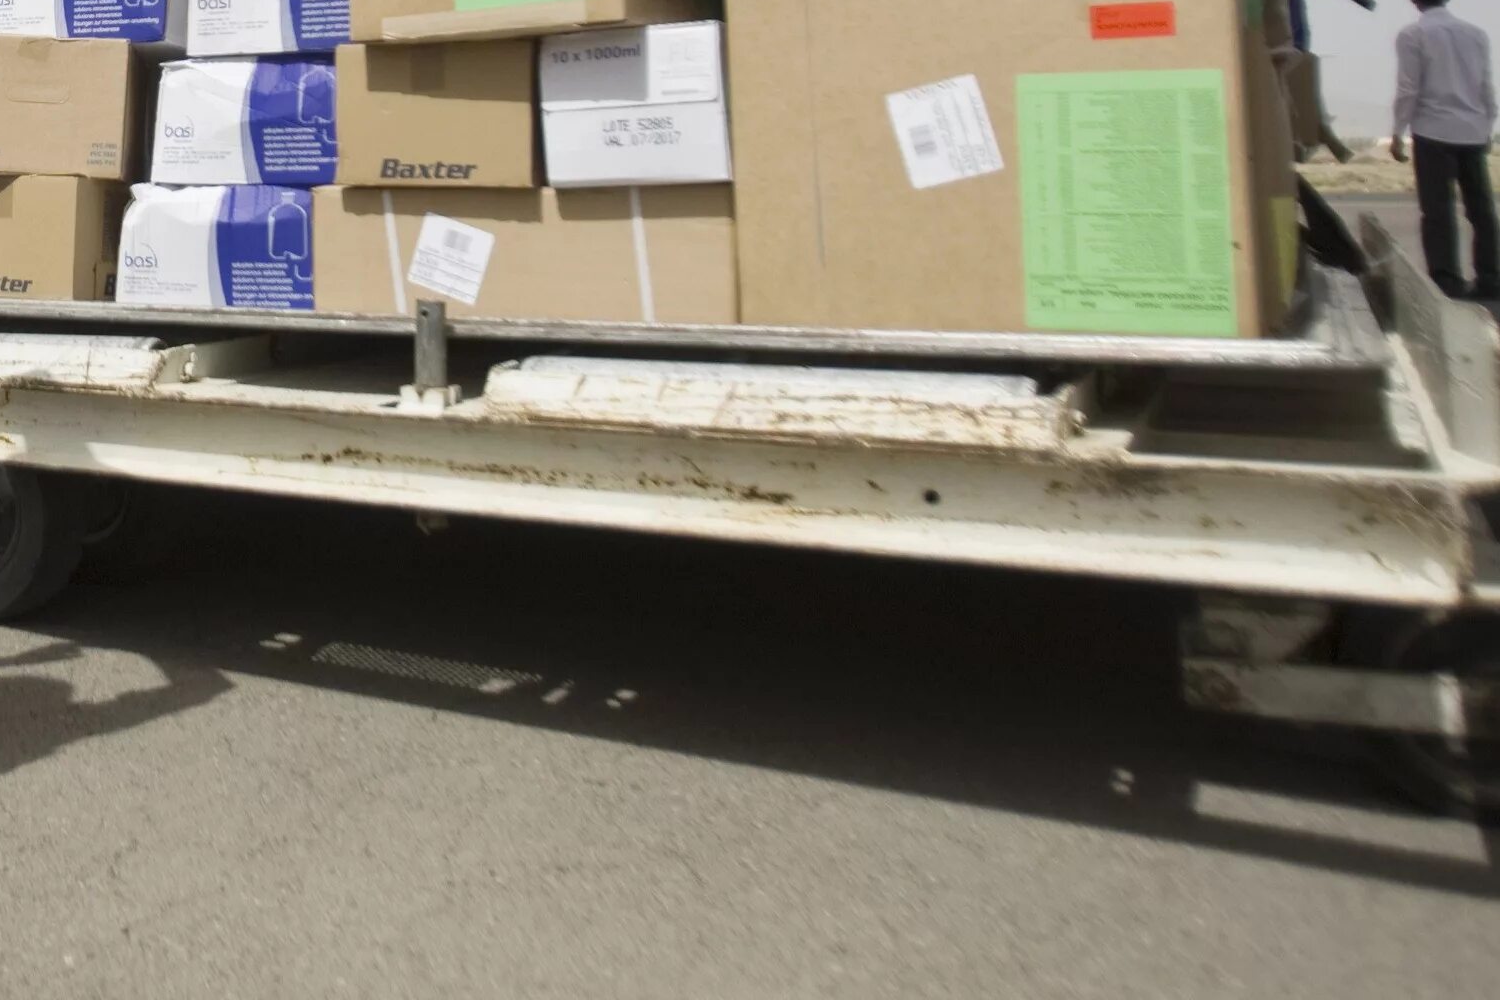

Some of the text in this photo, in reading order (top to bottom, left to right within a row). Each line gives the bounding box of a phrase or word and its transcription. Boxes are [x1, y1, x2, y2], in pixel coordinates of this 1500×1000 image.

[551, 43, 641, 64] 10 x 1000ml
[164, 121, 195, 138] basi
[379, 158, 478, 180] Baxter
[124, 249, 159, 269] basi
